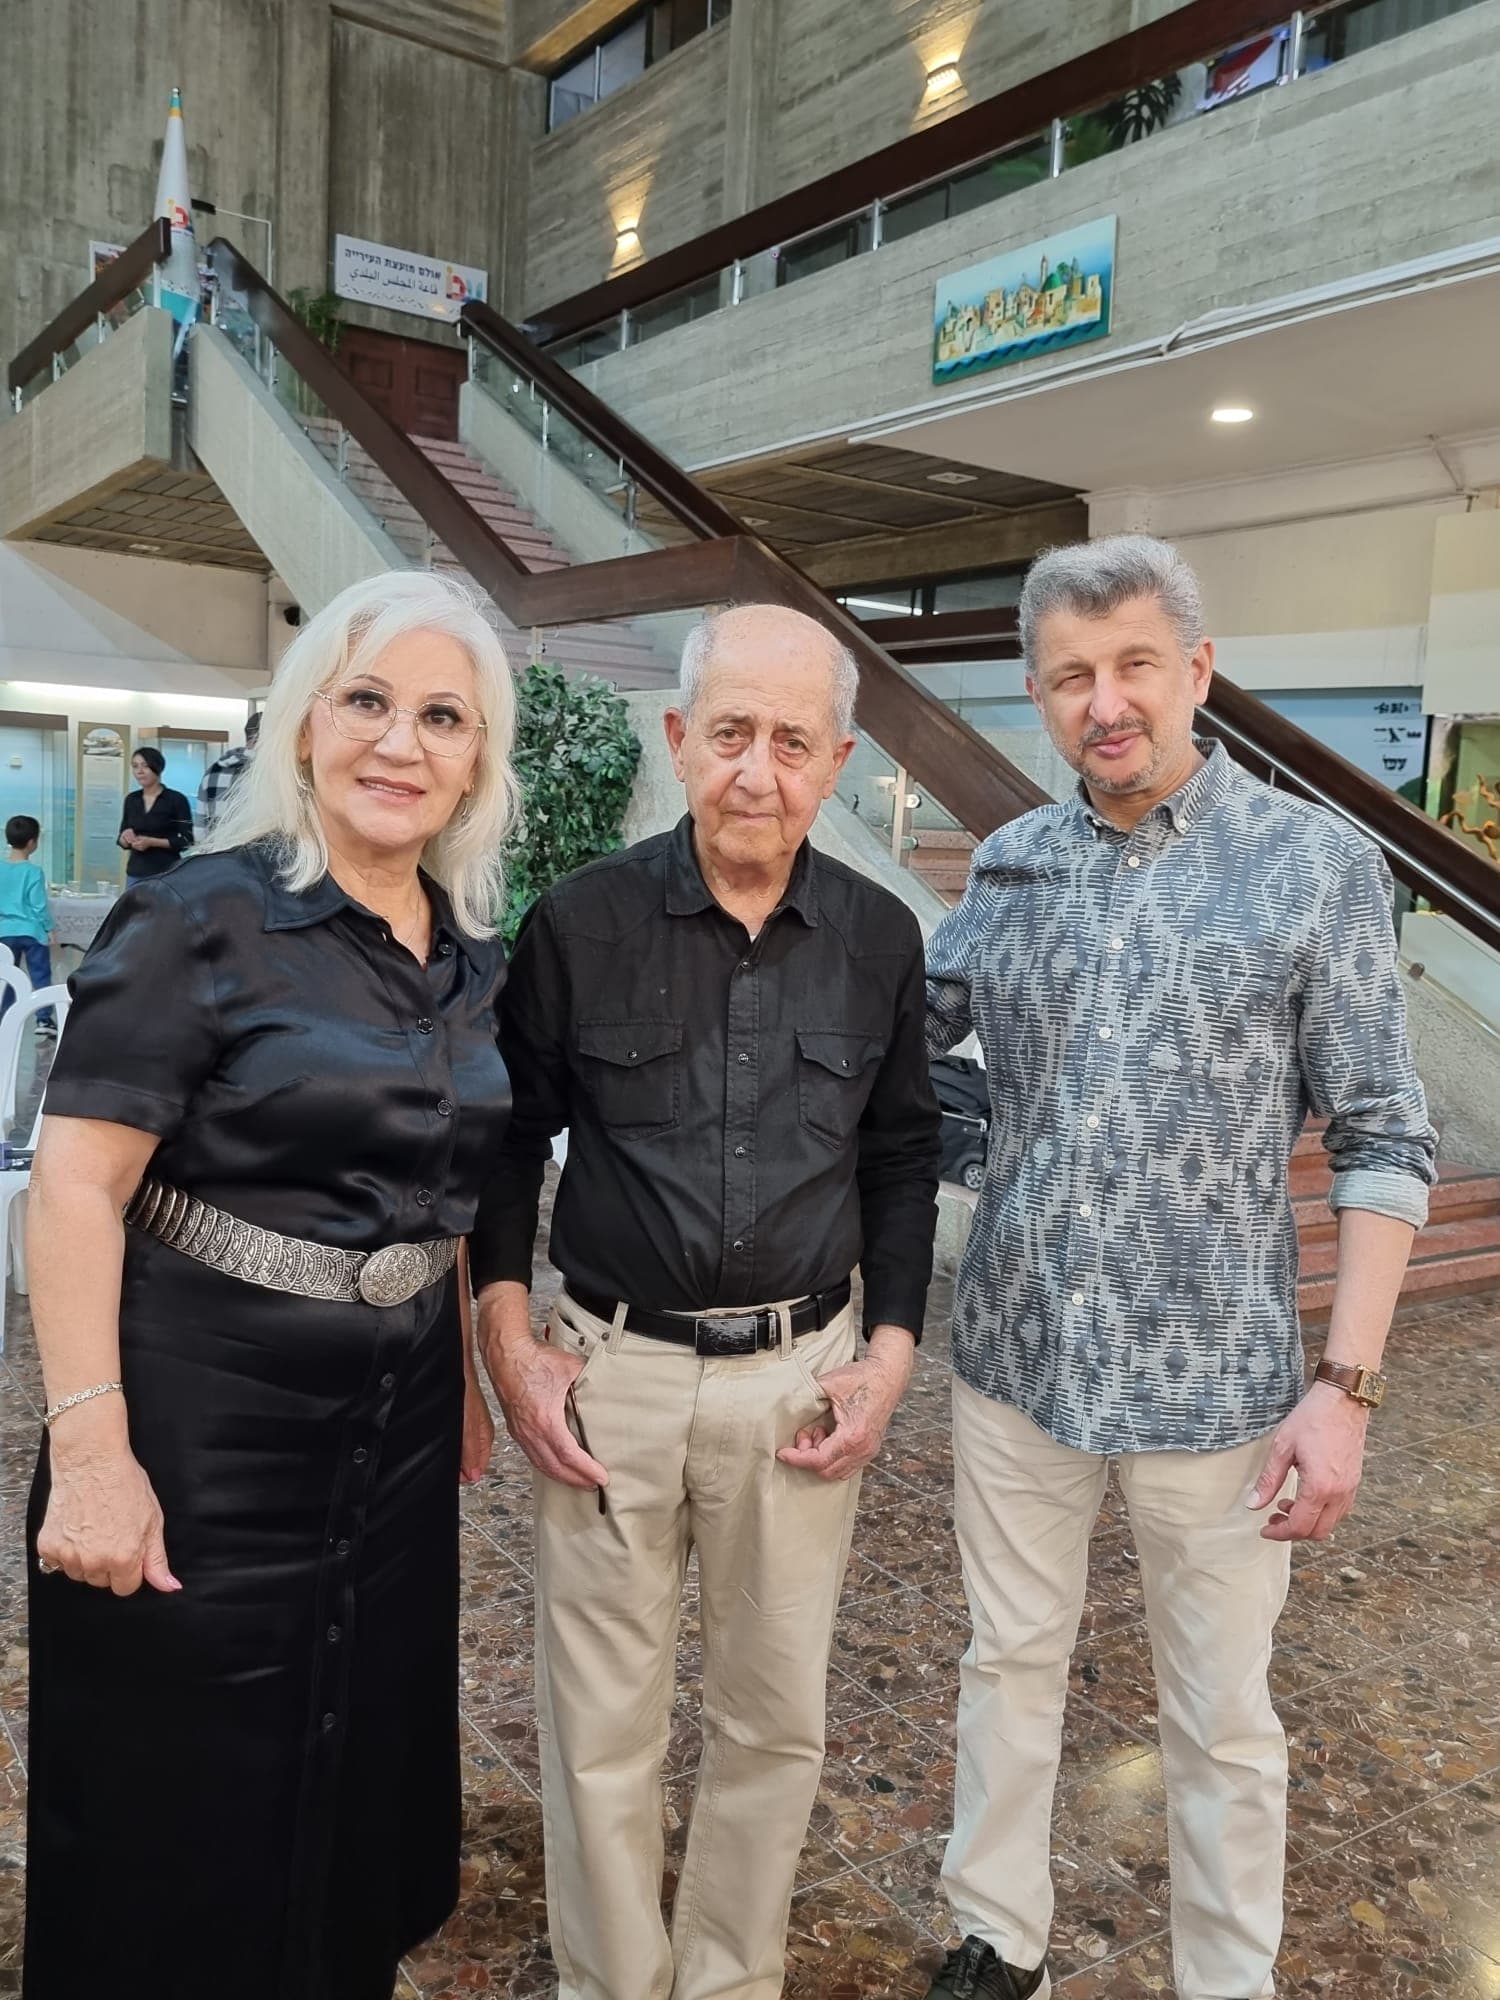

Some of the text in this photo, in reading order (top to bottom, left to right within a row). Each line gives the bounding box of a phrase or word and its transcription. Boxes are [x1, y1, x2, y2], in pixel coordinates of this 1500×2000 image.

[344, 248, 442, 280] אולם מועצת העירייה
[349, 267, 438, 295] قاعة المجلس البلدي
